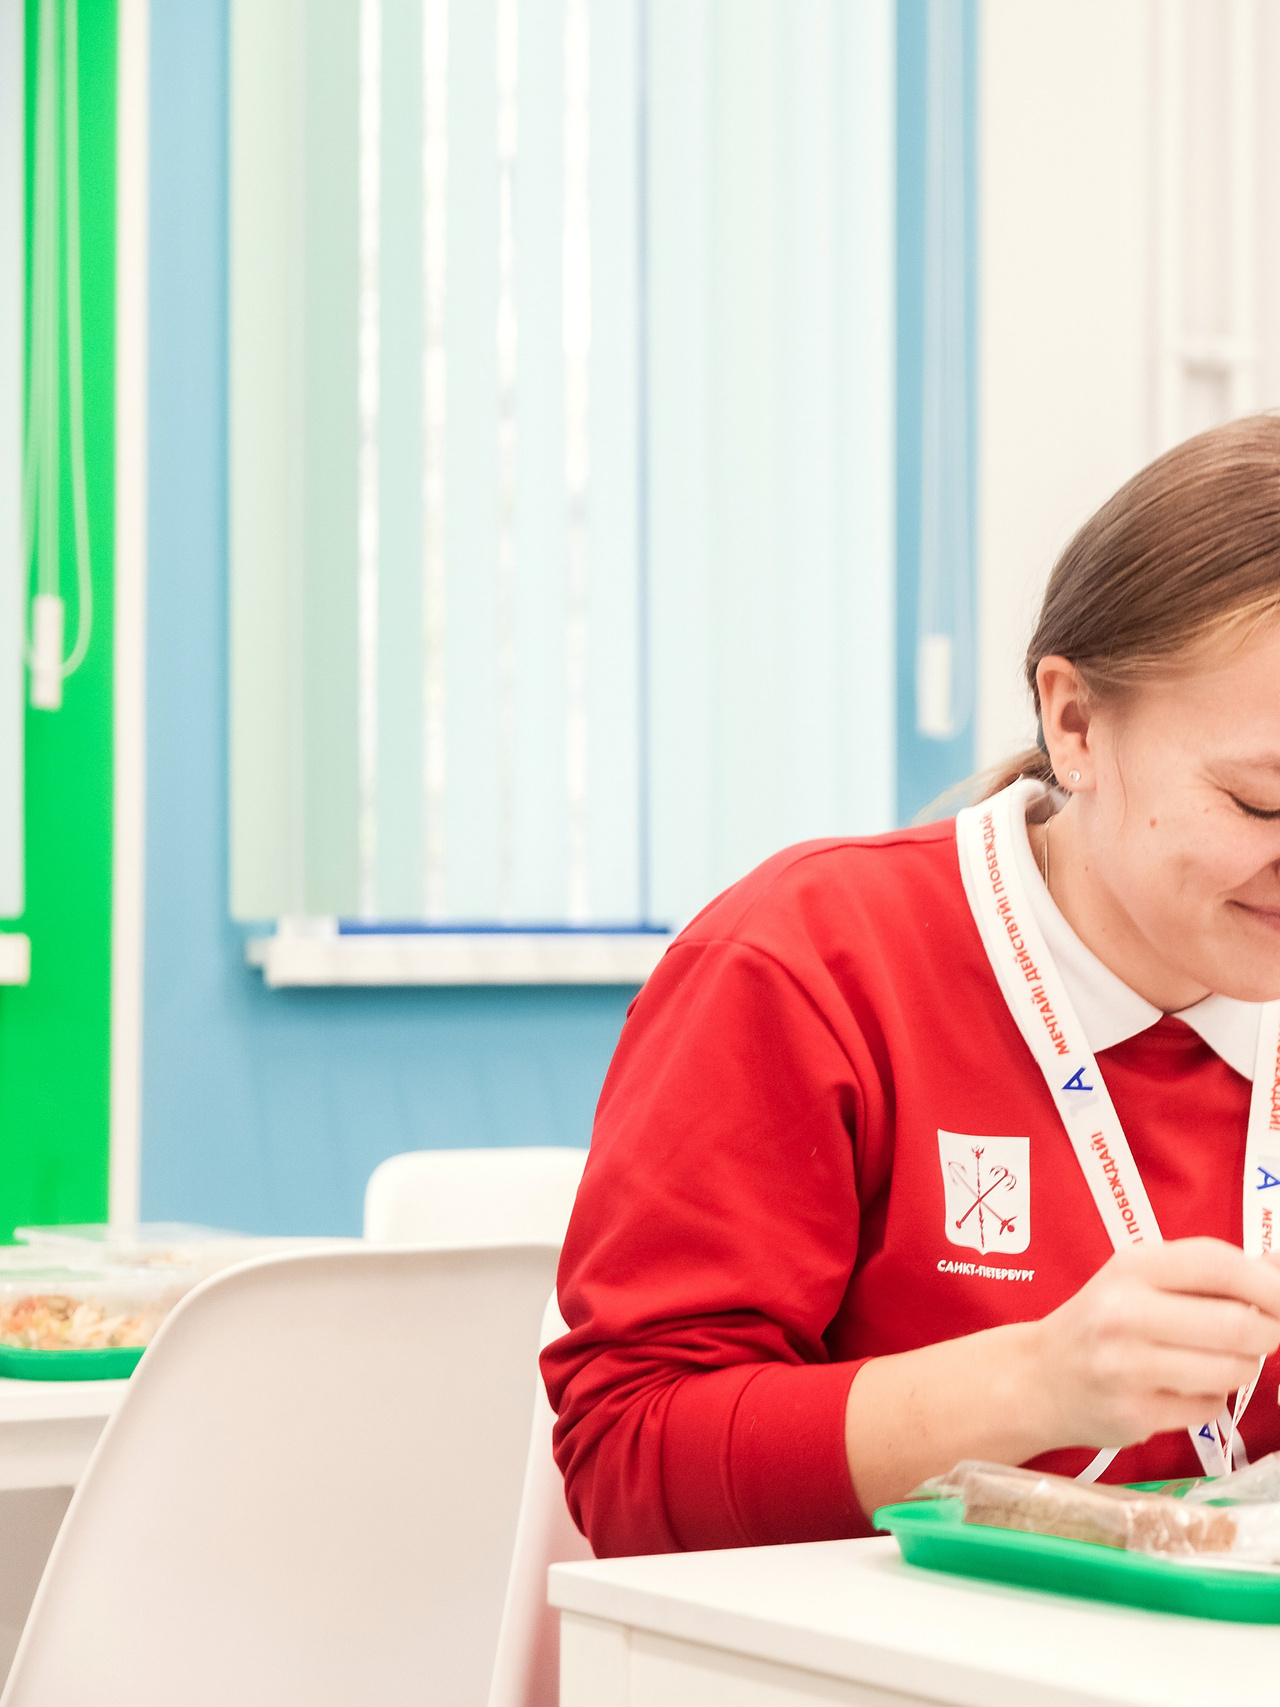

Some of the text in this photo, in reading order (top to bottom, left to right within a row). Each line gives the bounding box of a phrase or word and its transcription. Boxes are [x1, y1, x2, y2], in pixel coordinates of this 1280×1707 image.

[997, 896, 1041, 982] ДЕЙСТВУЙ!
[1031, 985, 1070, 1055] МЕЧТАЙ!
[1090, 1131, 1140, 1235] ПОБЕЖДАЙ!
[936, 1259, 1035, 1282] САНКТ-ПЕТЕРБУРГ
